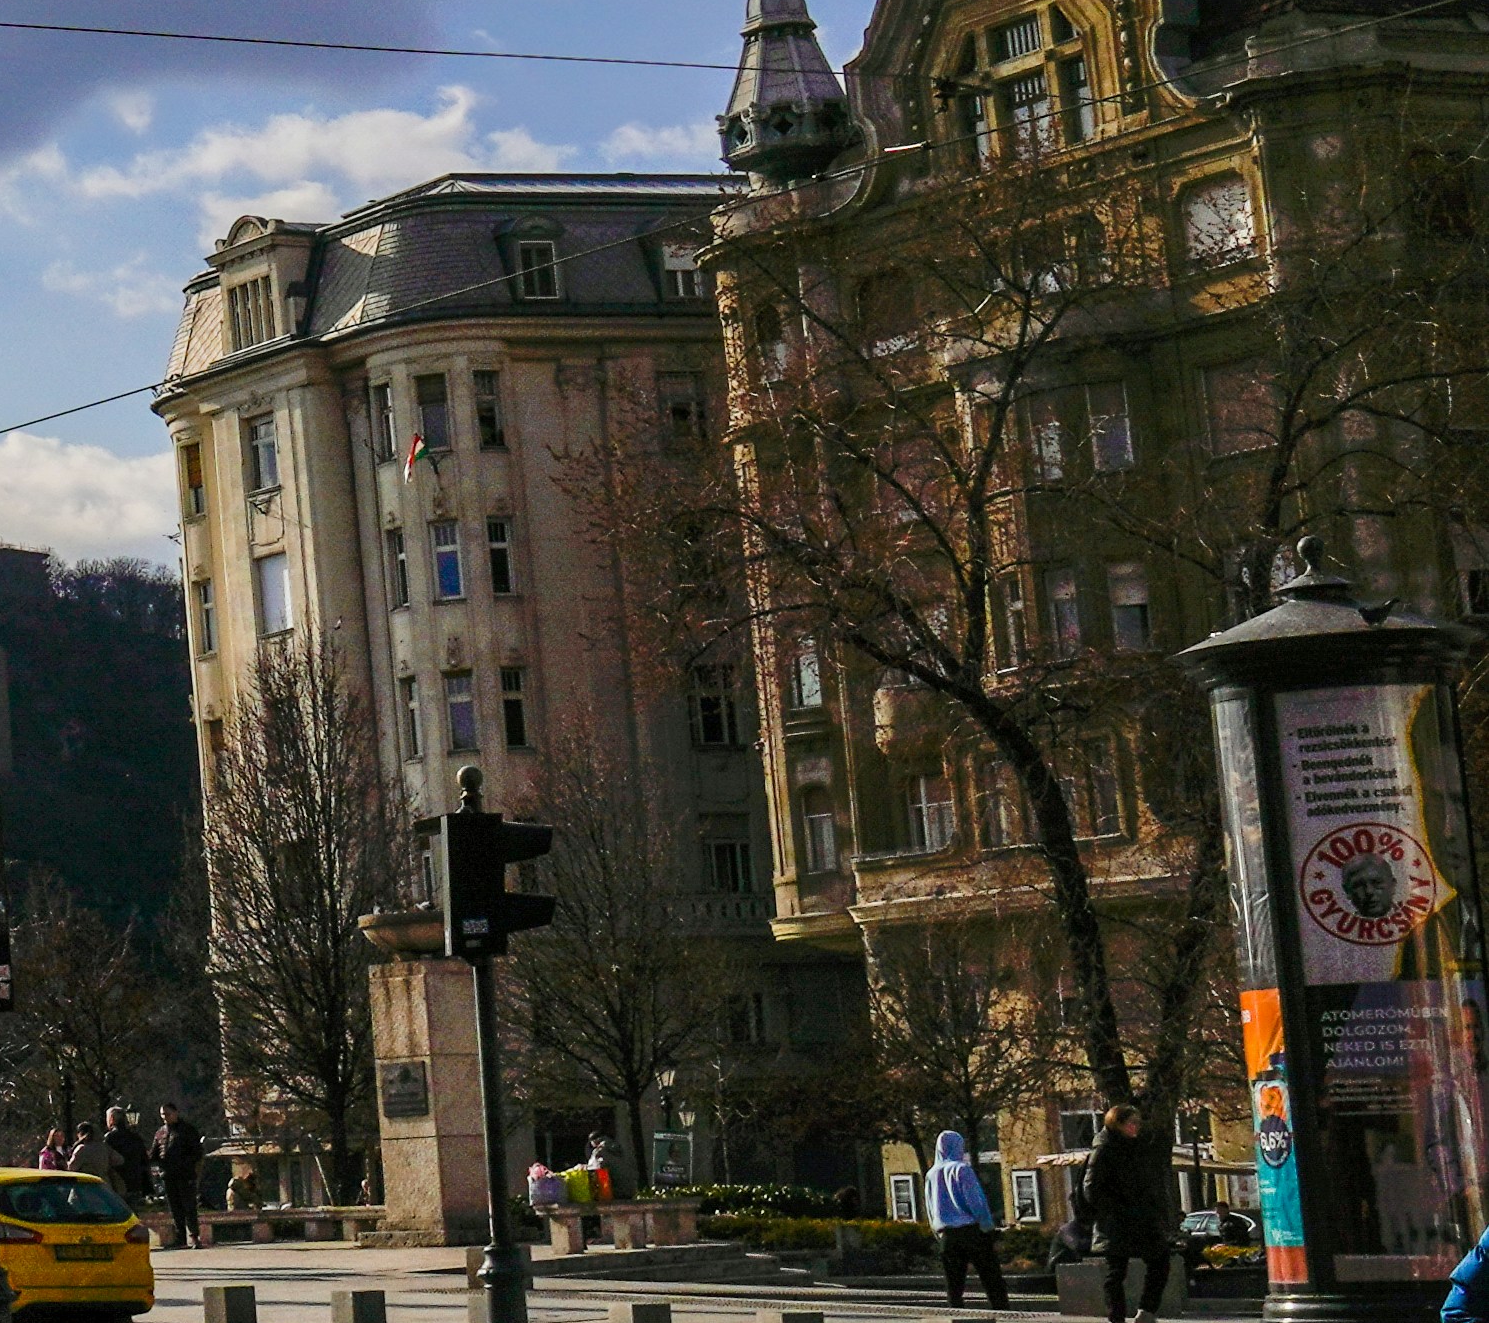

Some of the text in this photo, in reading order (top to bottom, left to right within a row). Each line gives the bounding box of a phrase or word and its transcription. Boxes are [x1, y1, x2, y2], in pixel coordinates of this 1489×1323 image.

[1317, 829, 1405, 869] 100%
[1324, 1041, 1376, 1053] NEKED
[1380, 1040, 1395, 1050] IS
